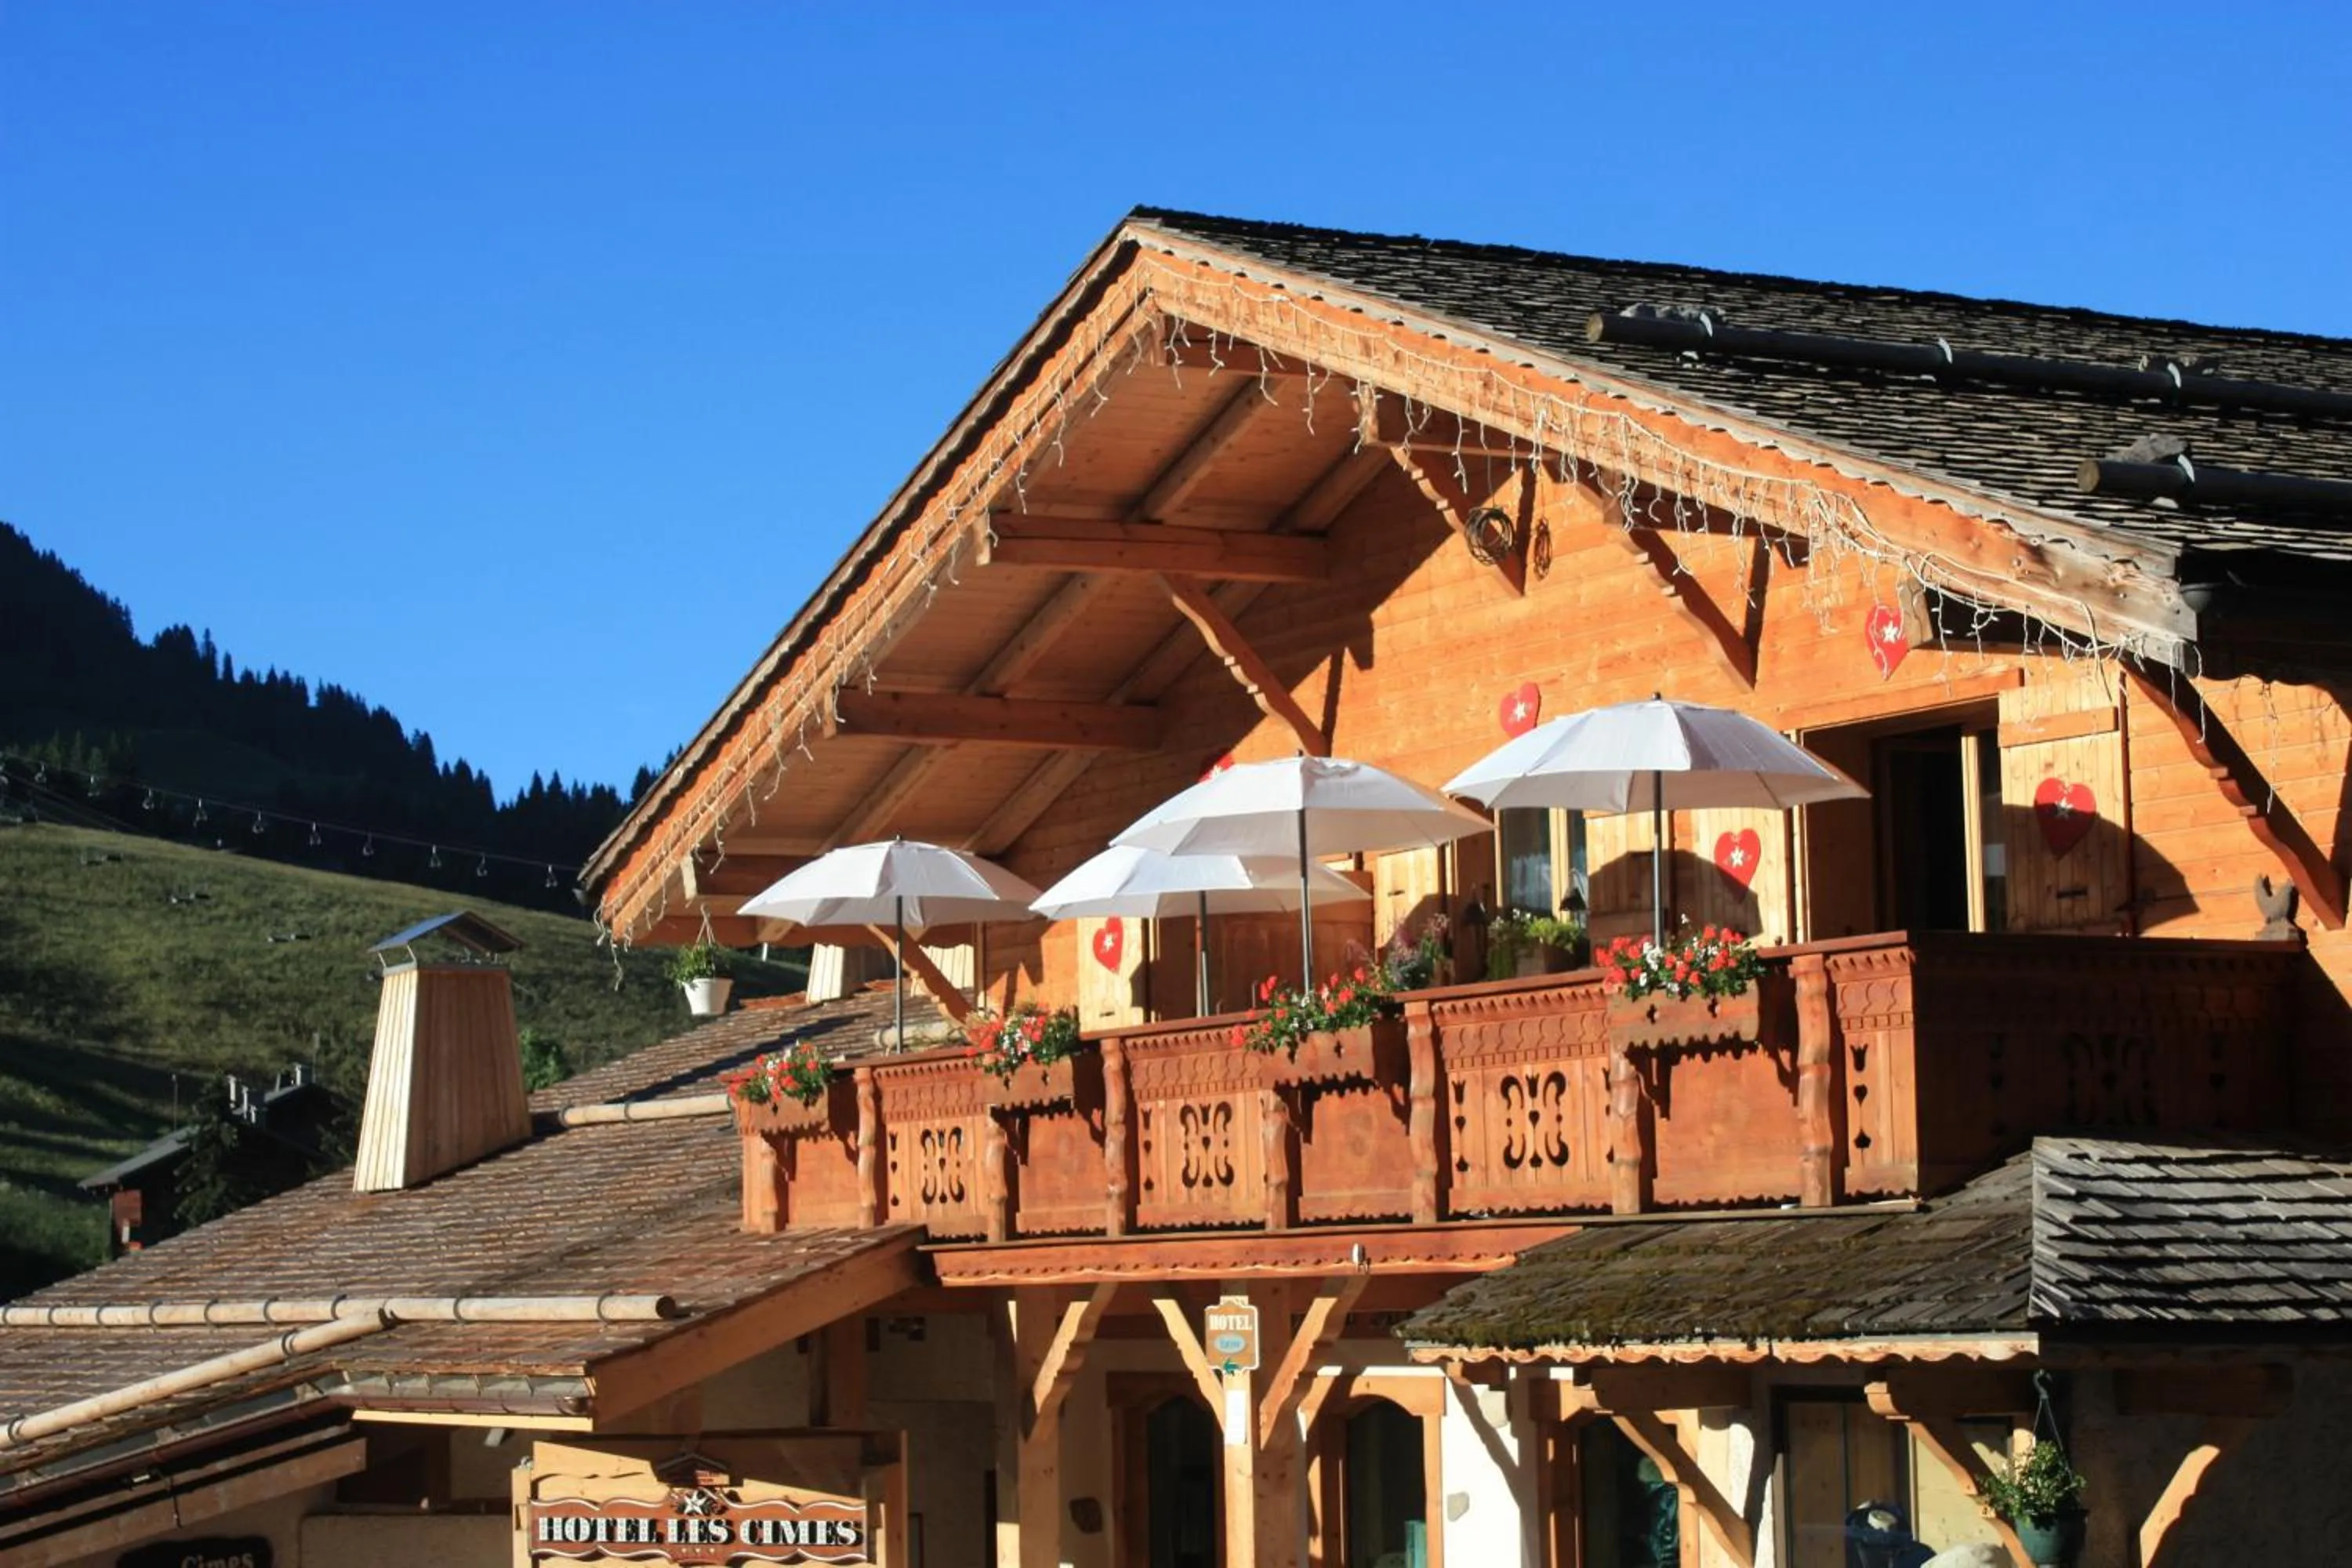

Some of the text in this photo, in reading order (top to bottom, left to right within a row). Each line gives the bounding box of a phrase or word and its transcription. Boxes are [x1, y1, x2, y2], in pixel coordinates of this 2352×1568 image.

[1209, 1314, 1254, 1330] HOTEL
[539, 1516, 861, 1544] HOTEL LES CIMES
